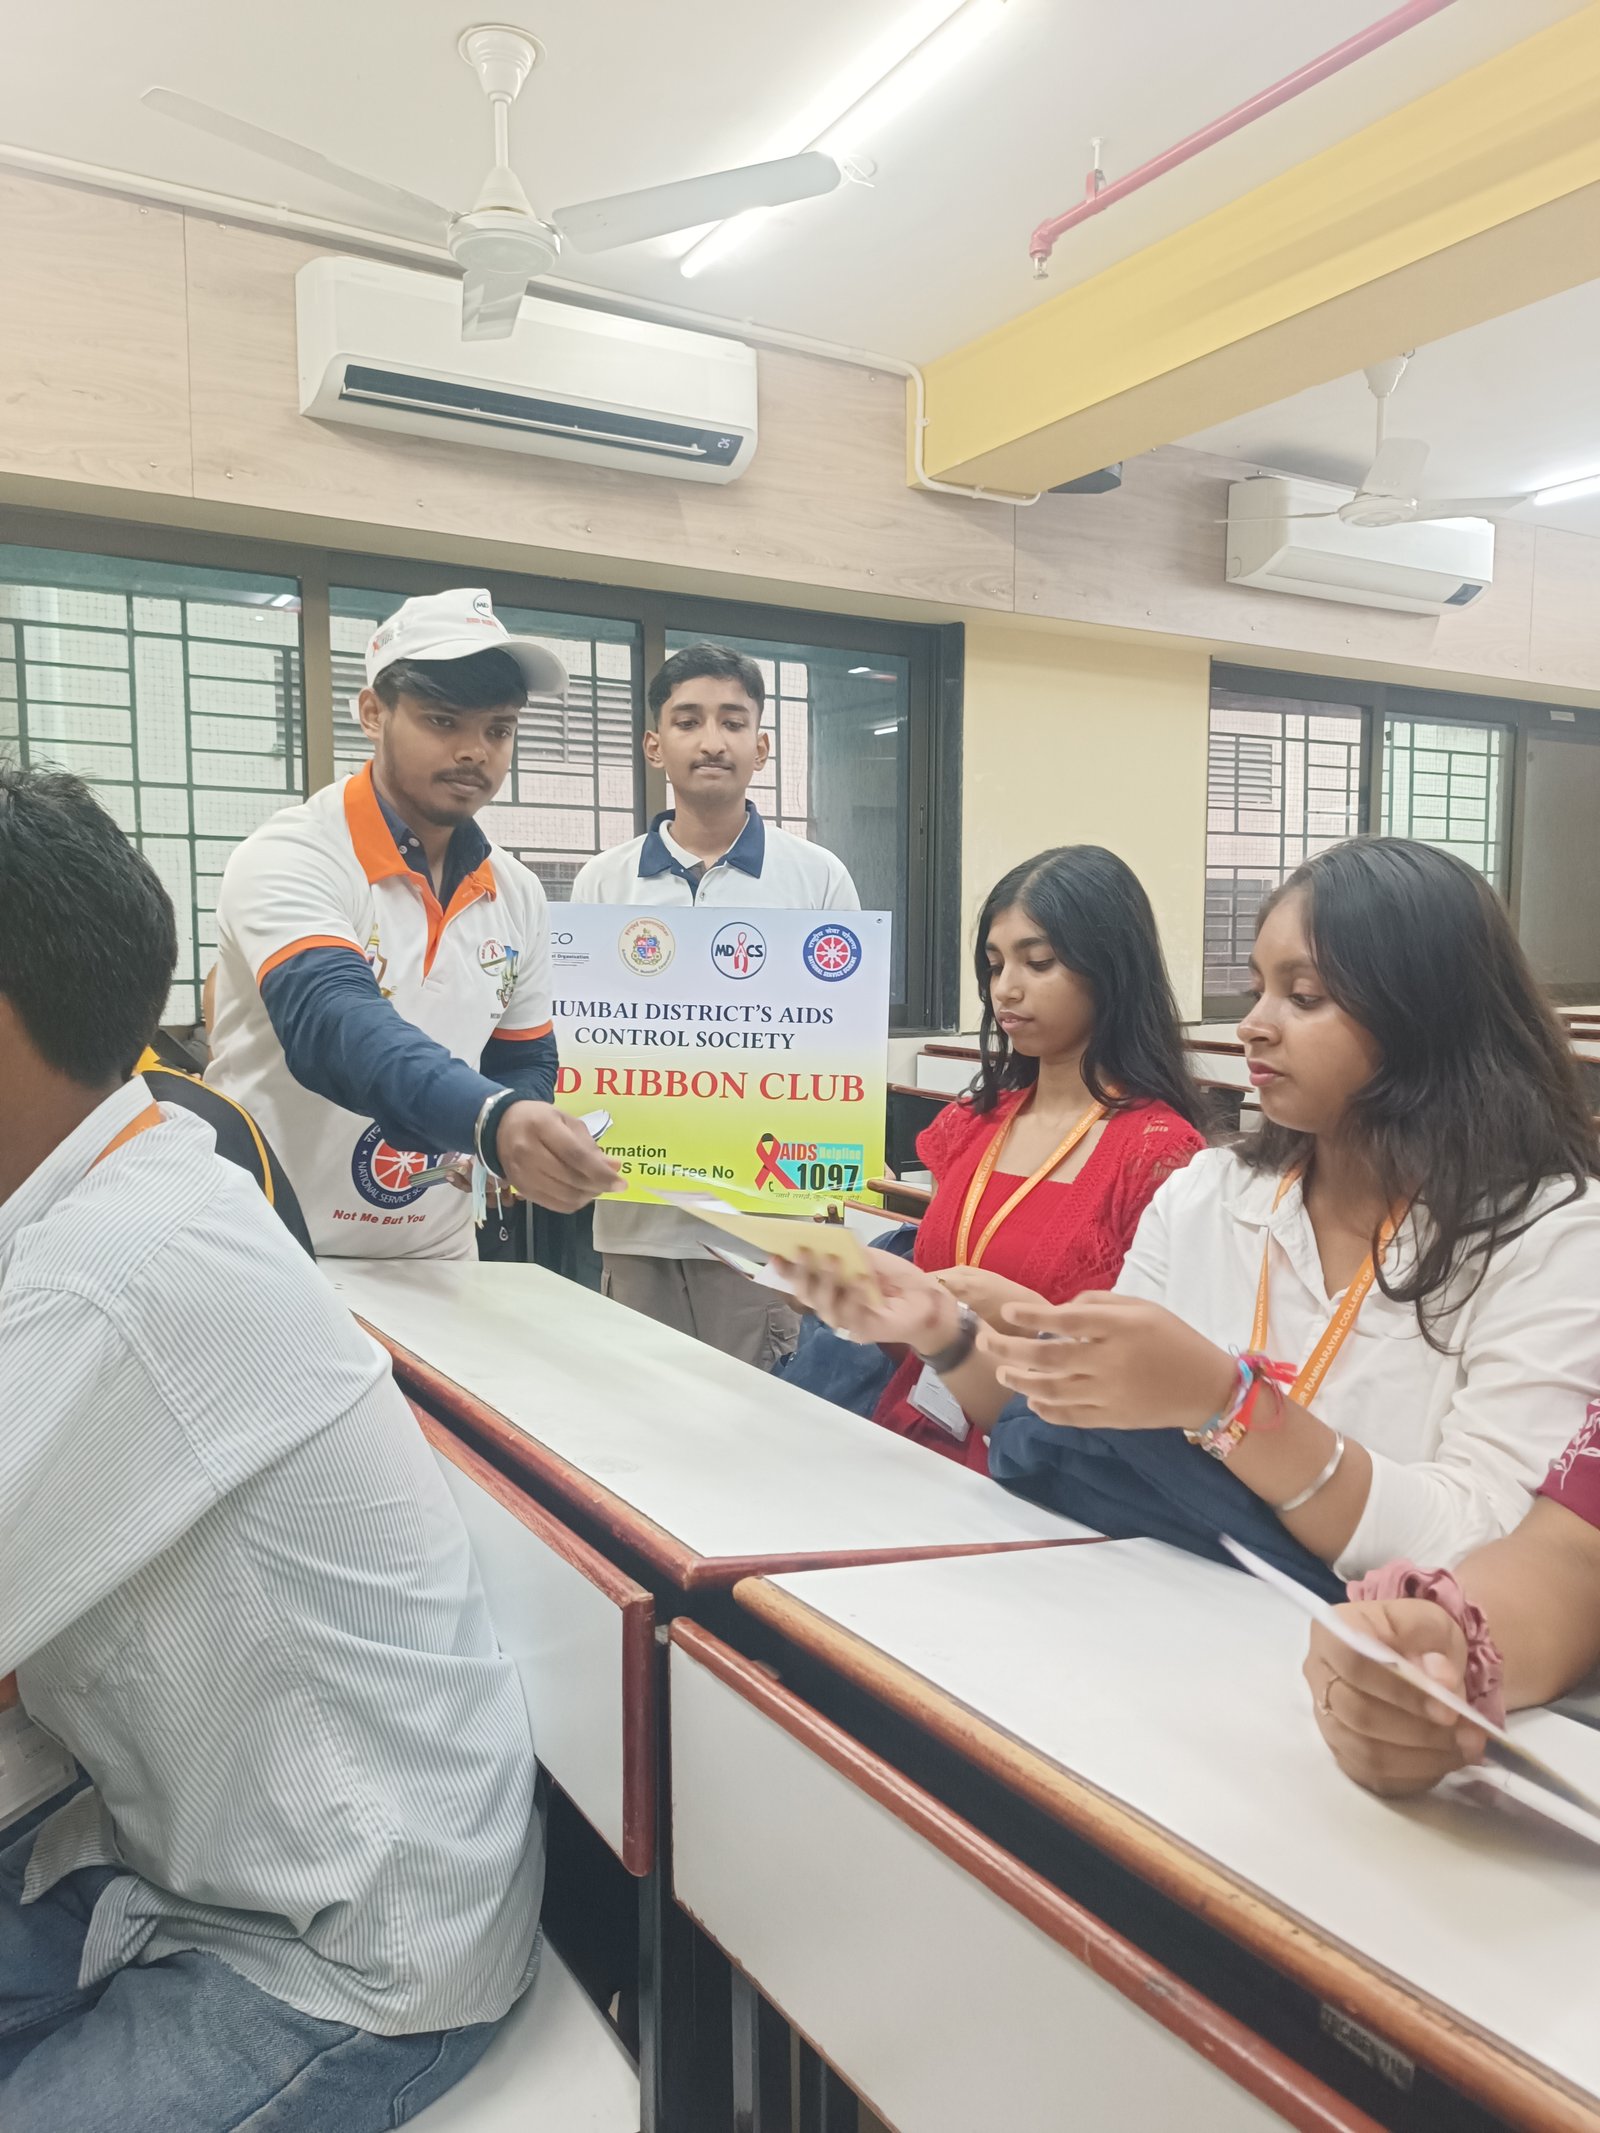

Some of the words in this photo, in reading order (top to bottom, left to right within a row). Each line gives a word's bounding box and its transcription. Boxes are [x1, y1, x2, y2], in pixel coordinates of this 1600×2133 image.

[778, 1007, 834, 1024] AIDS
[575, 1027, 690, 1047] CONTROL
[695, 1031, 795, 1049] SOCIETY
[593, 1067, 748, 1100] RIBBON
[759, 1073, 865, 1102] CLUB
[780, 1143, 817, 1161] AIDS
[638, 1163, 666, 1176] Toll
[671, 1164, 707, 1178] Free
[712, 1165, 734, 1179] No
[797, 1163, 859, 1191] 1097
[358, 1161, 379, 1199] NATIONAL
[378, 1192, 411, 1204] SERVICE
[332, 1209, 357, 1221] Not
[360, 1213, 379, 1224] Me
[382, 1216, 402, 1225] But
[406, 1214, 426, 1224] You
[1303, 1325, 1344, 1392] RAMNARAYAN
[1340, 1282, 1366, 1327] COLLEGE
[1362, 1268, 1374, 1283] OF
